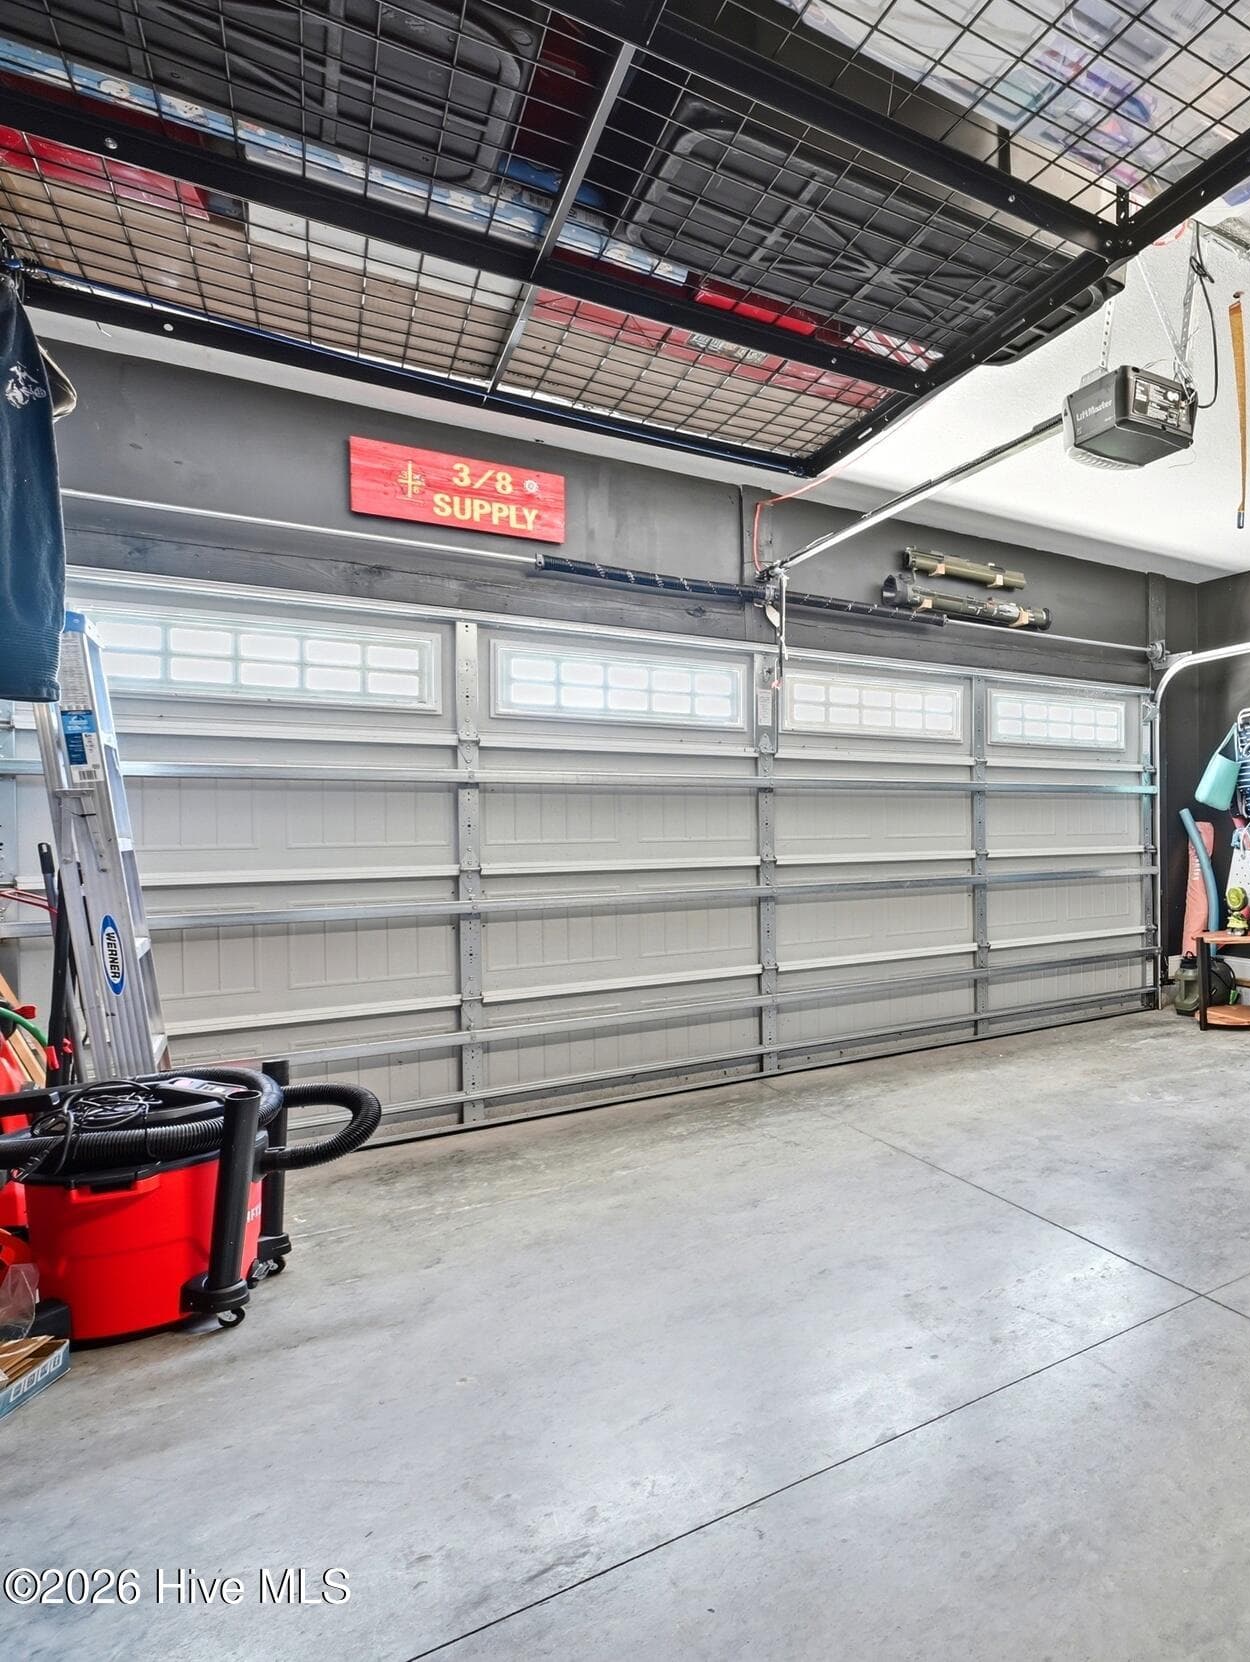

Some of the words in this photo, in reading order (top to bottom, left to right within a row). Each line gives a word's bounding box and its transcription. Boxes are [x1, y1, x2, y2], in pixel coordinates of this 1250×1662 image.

[452, 463, 513, 494] 3/8
[433, 493, 538, 530] SUPPLY
[105, 932, 121, 979] WERNER
